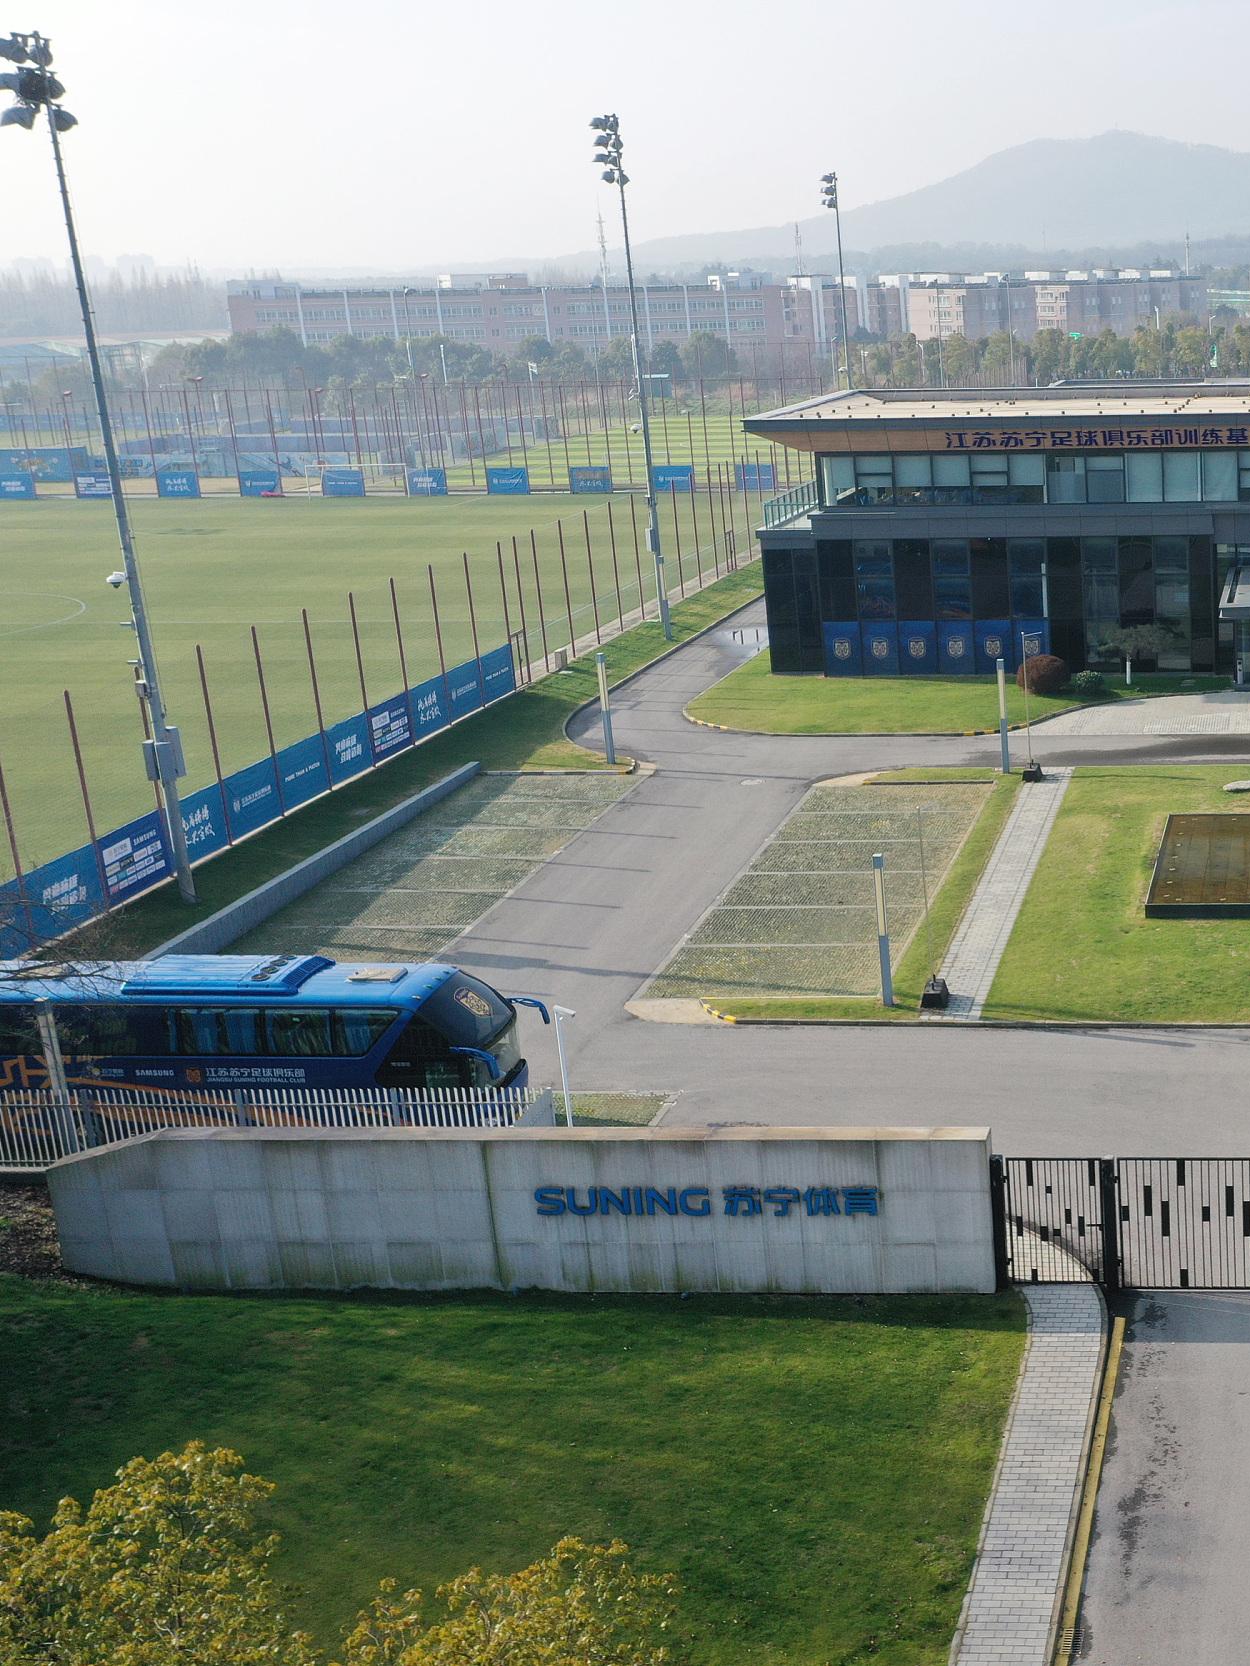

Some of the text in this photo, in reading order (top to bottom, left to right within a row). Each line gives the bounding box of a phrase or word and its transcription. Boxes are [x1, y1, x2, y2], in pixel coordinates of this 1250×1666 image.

[133, 829, 157, 846] SAMSUNG
[135, 1069, 175, 1077] SAMSUNG
[205, 1068, 305, 1078] 江苏苏宁足球俱乐部
[533, 1185, 880, 1217] SUNING 苏宁体育
